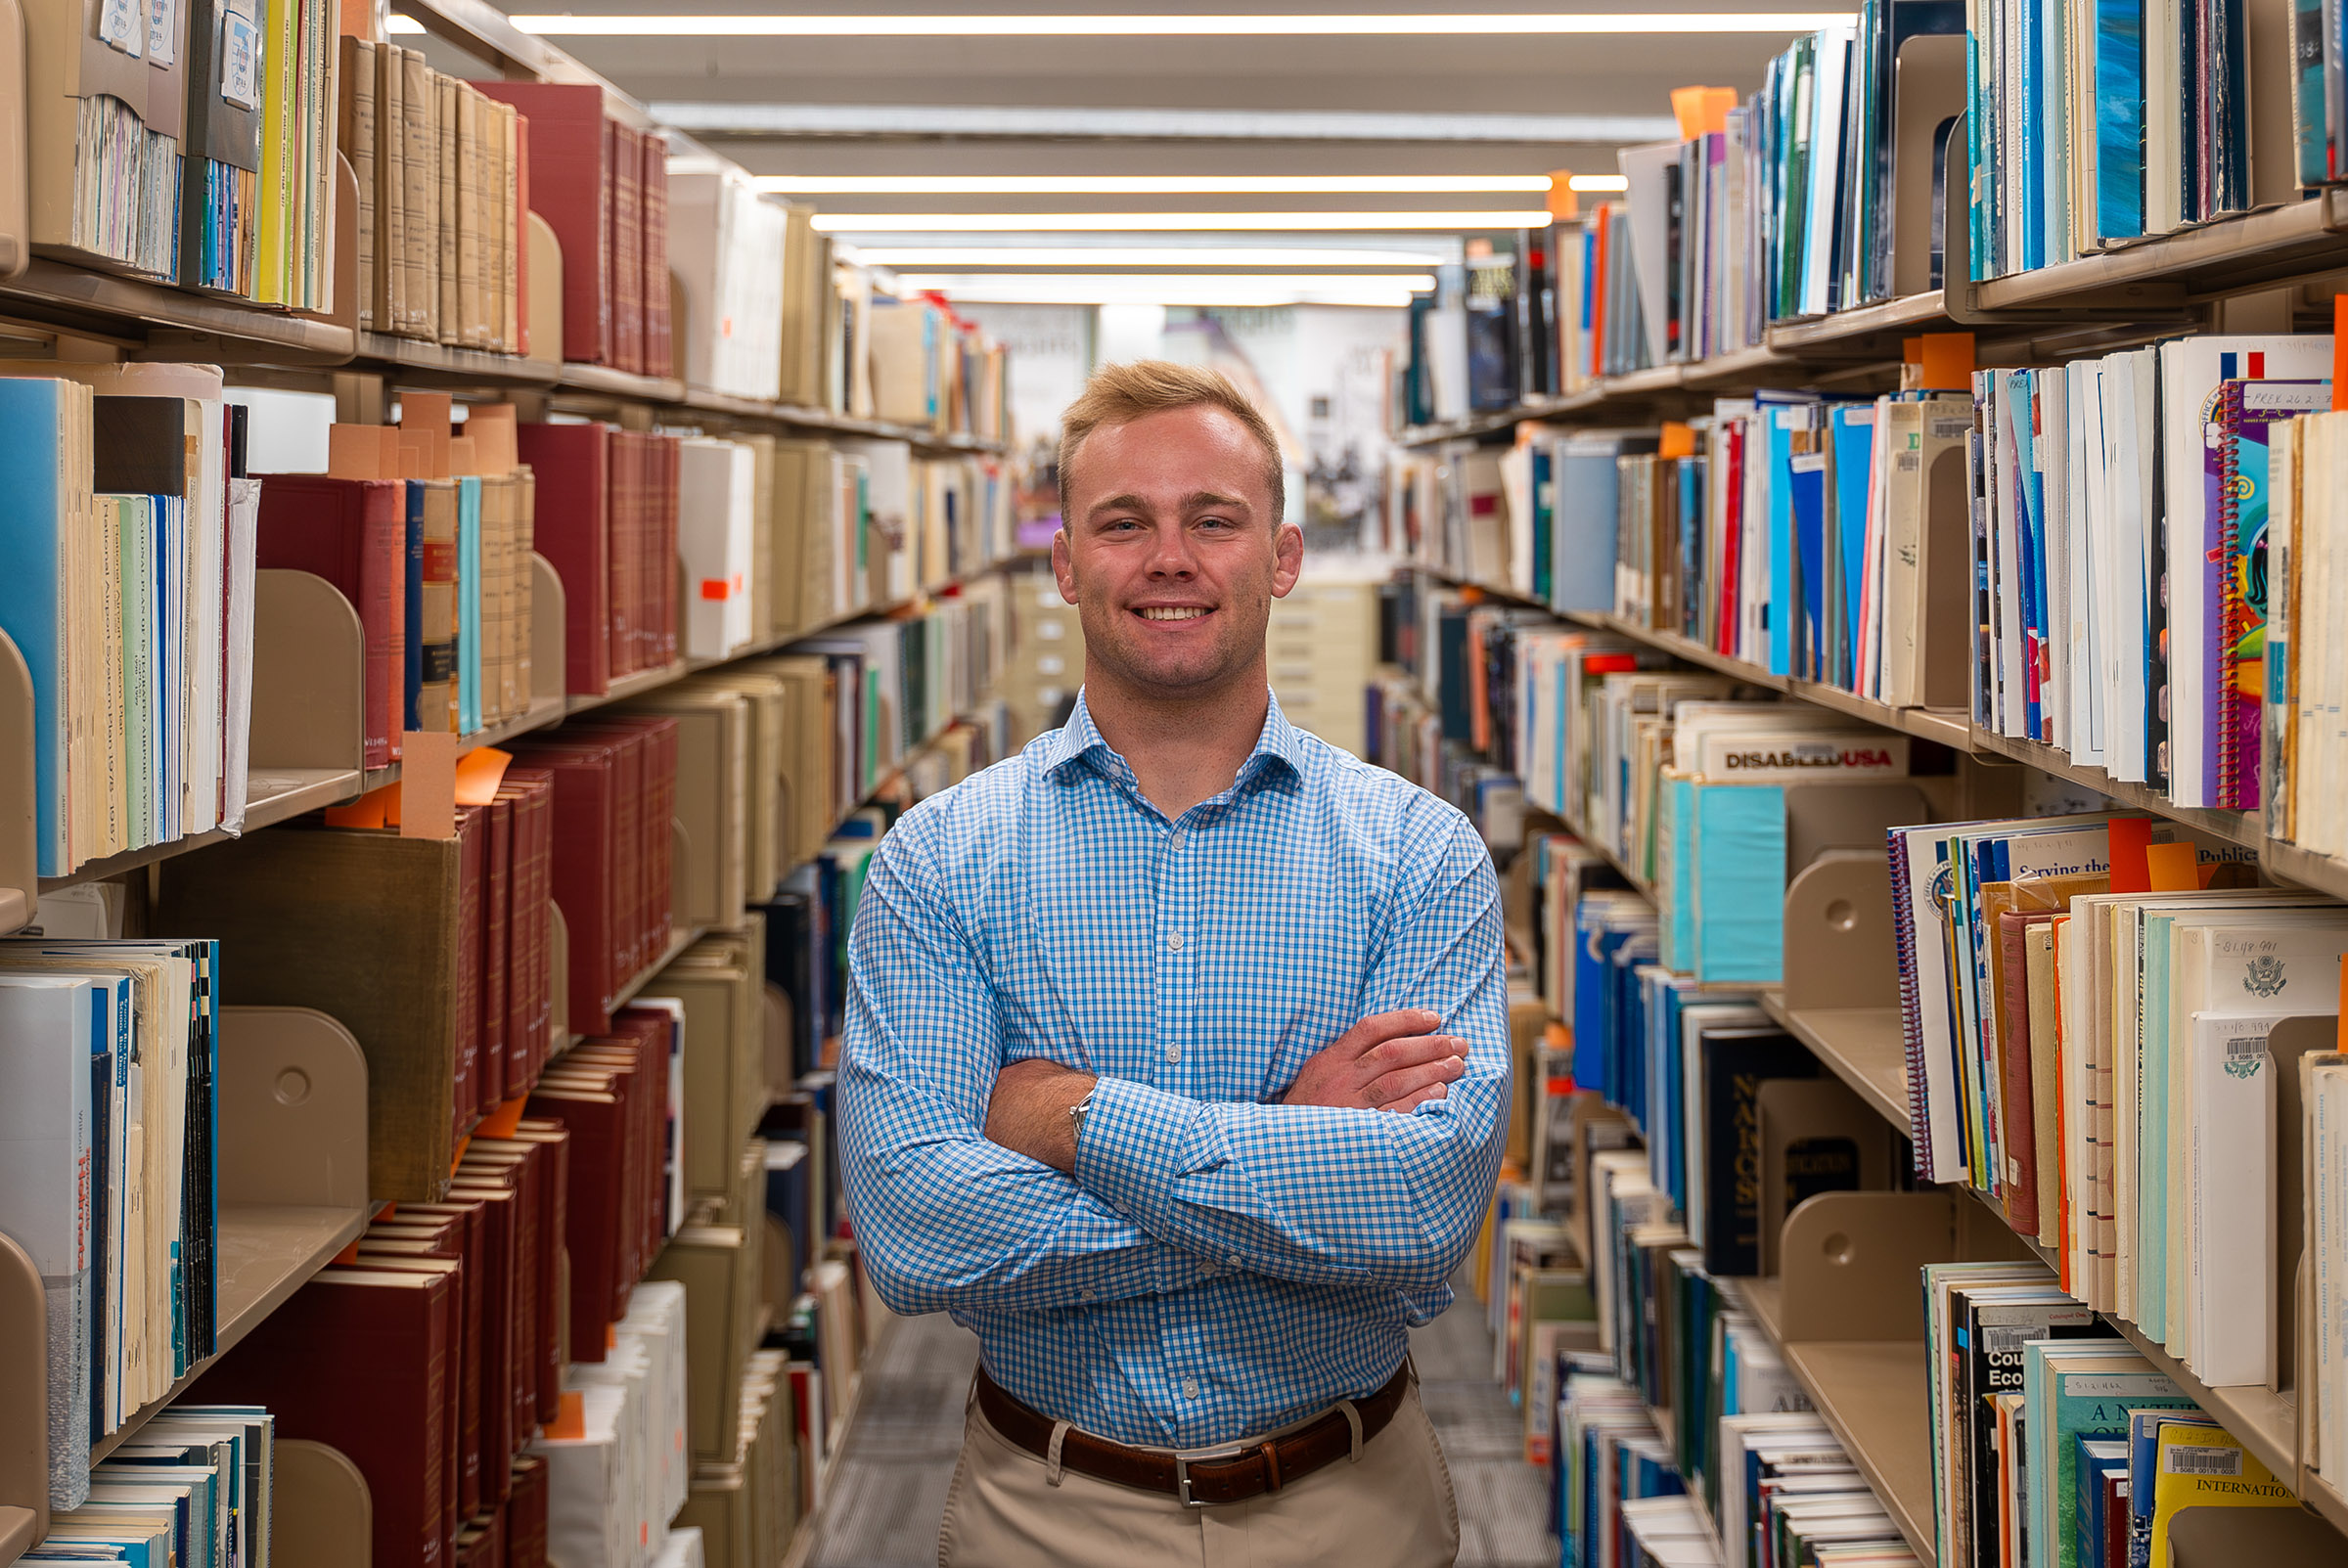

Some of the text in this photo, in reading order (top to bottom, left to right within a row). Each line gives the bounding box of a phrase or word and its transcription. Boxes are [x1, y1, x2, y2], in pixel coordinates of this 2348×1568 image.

[1843, 749, 1892, 768] USA
[2083, 858, 2110, 874] the
[77, 1157, 86, 1273] Helmets
[1989, 1369, 2023, 1386] Eco
[2091, 1404, 2108, 1421] A
